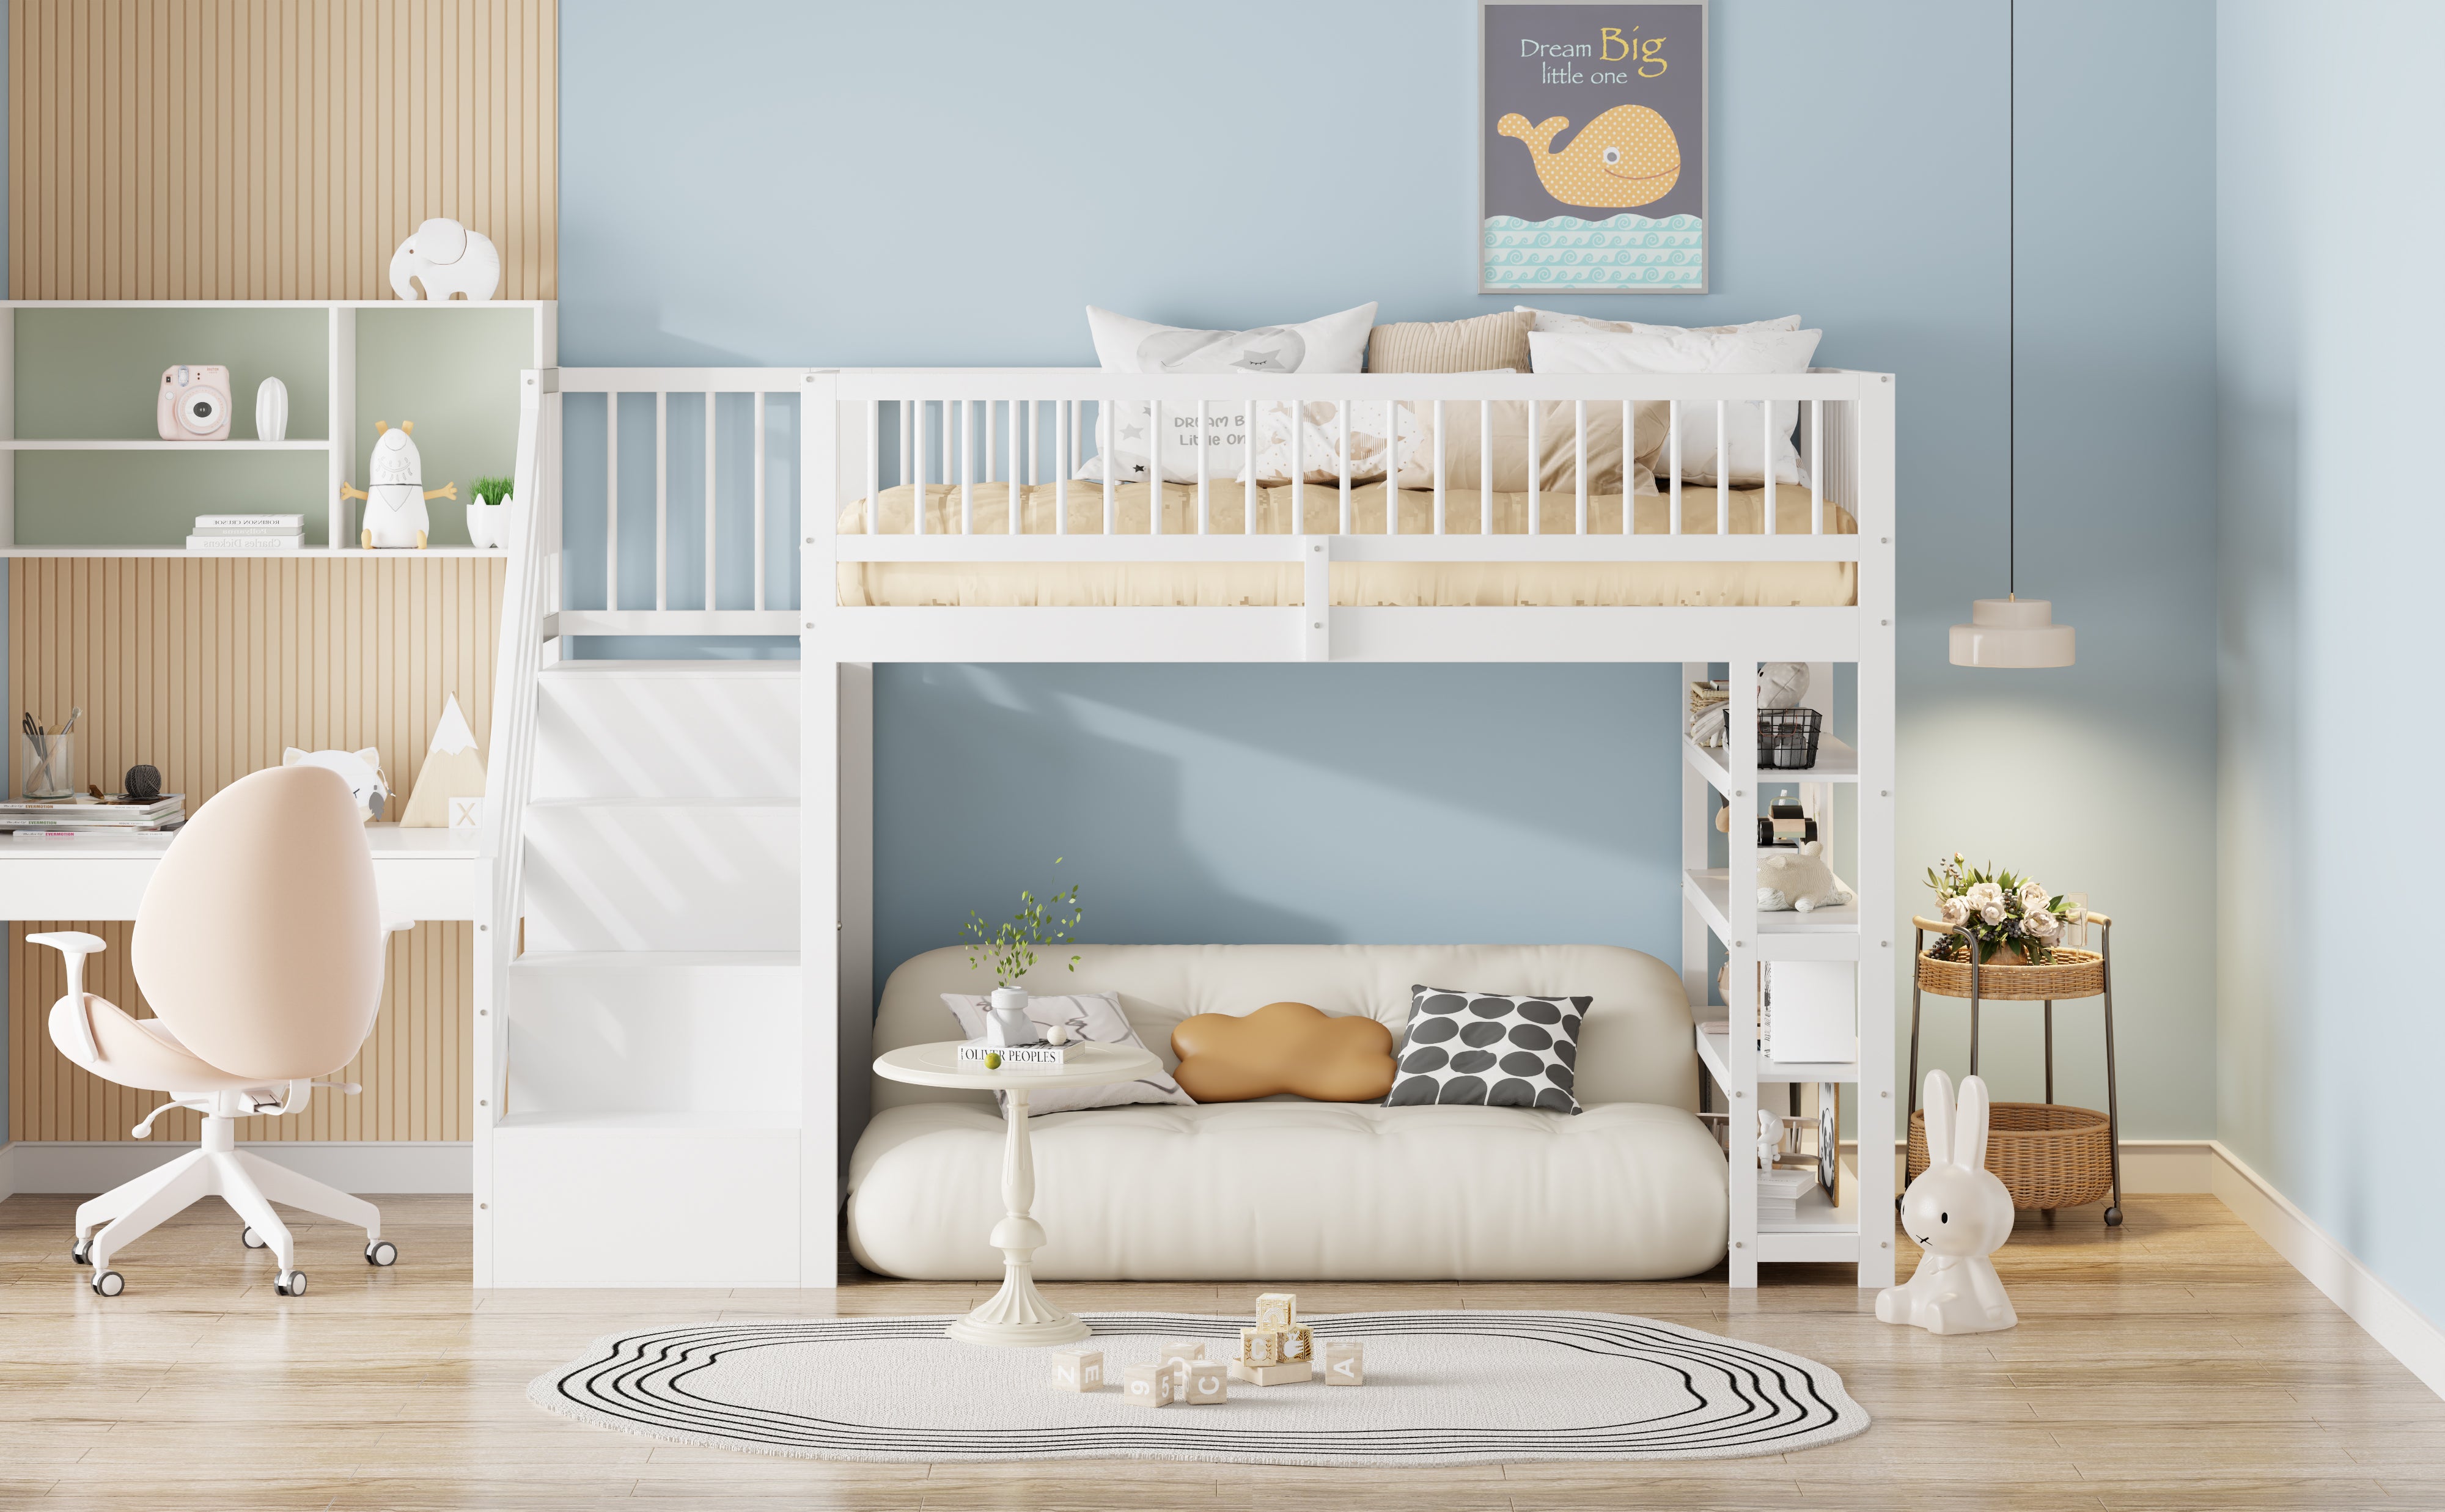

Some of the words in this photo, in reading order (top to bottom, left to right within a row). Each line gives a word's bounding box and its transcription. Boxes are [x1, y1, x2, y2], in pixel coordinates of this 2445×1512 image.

[1521, 39, 1591, 57] Dream
[1600, 26, 1667, 78] Big
[1542, 62, 1584, 84] little
[1590, 72, 1628, 84] one
[1180, 435, 1221, 446] Litle
[457, 802, 476, 826] X
[1009, 1050, 1056, 1063] PEOPLES
[1252, 1338, 1266, 1360] C
[1333, 1358, 1355, 1378] A
